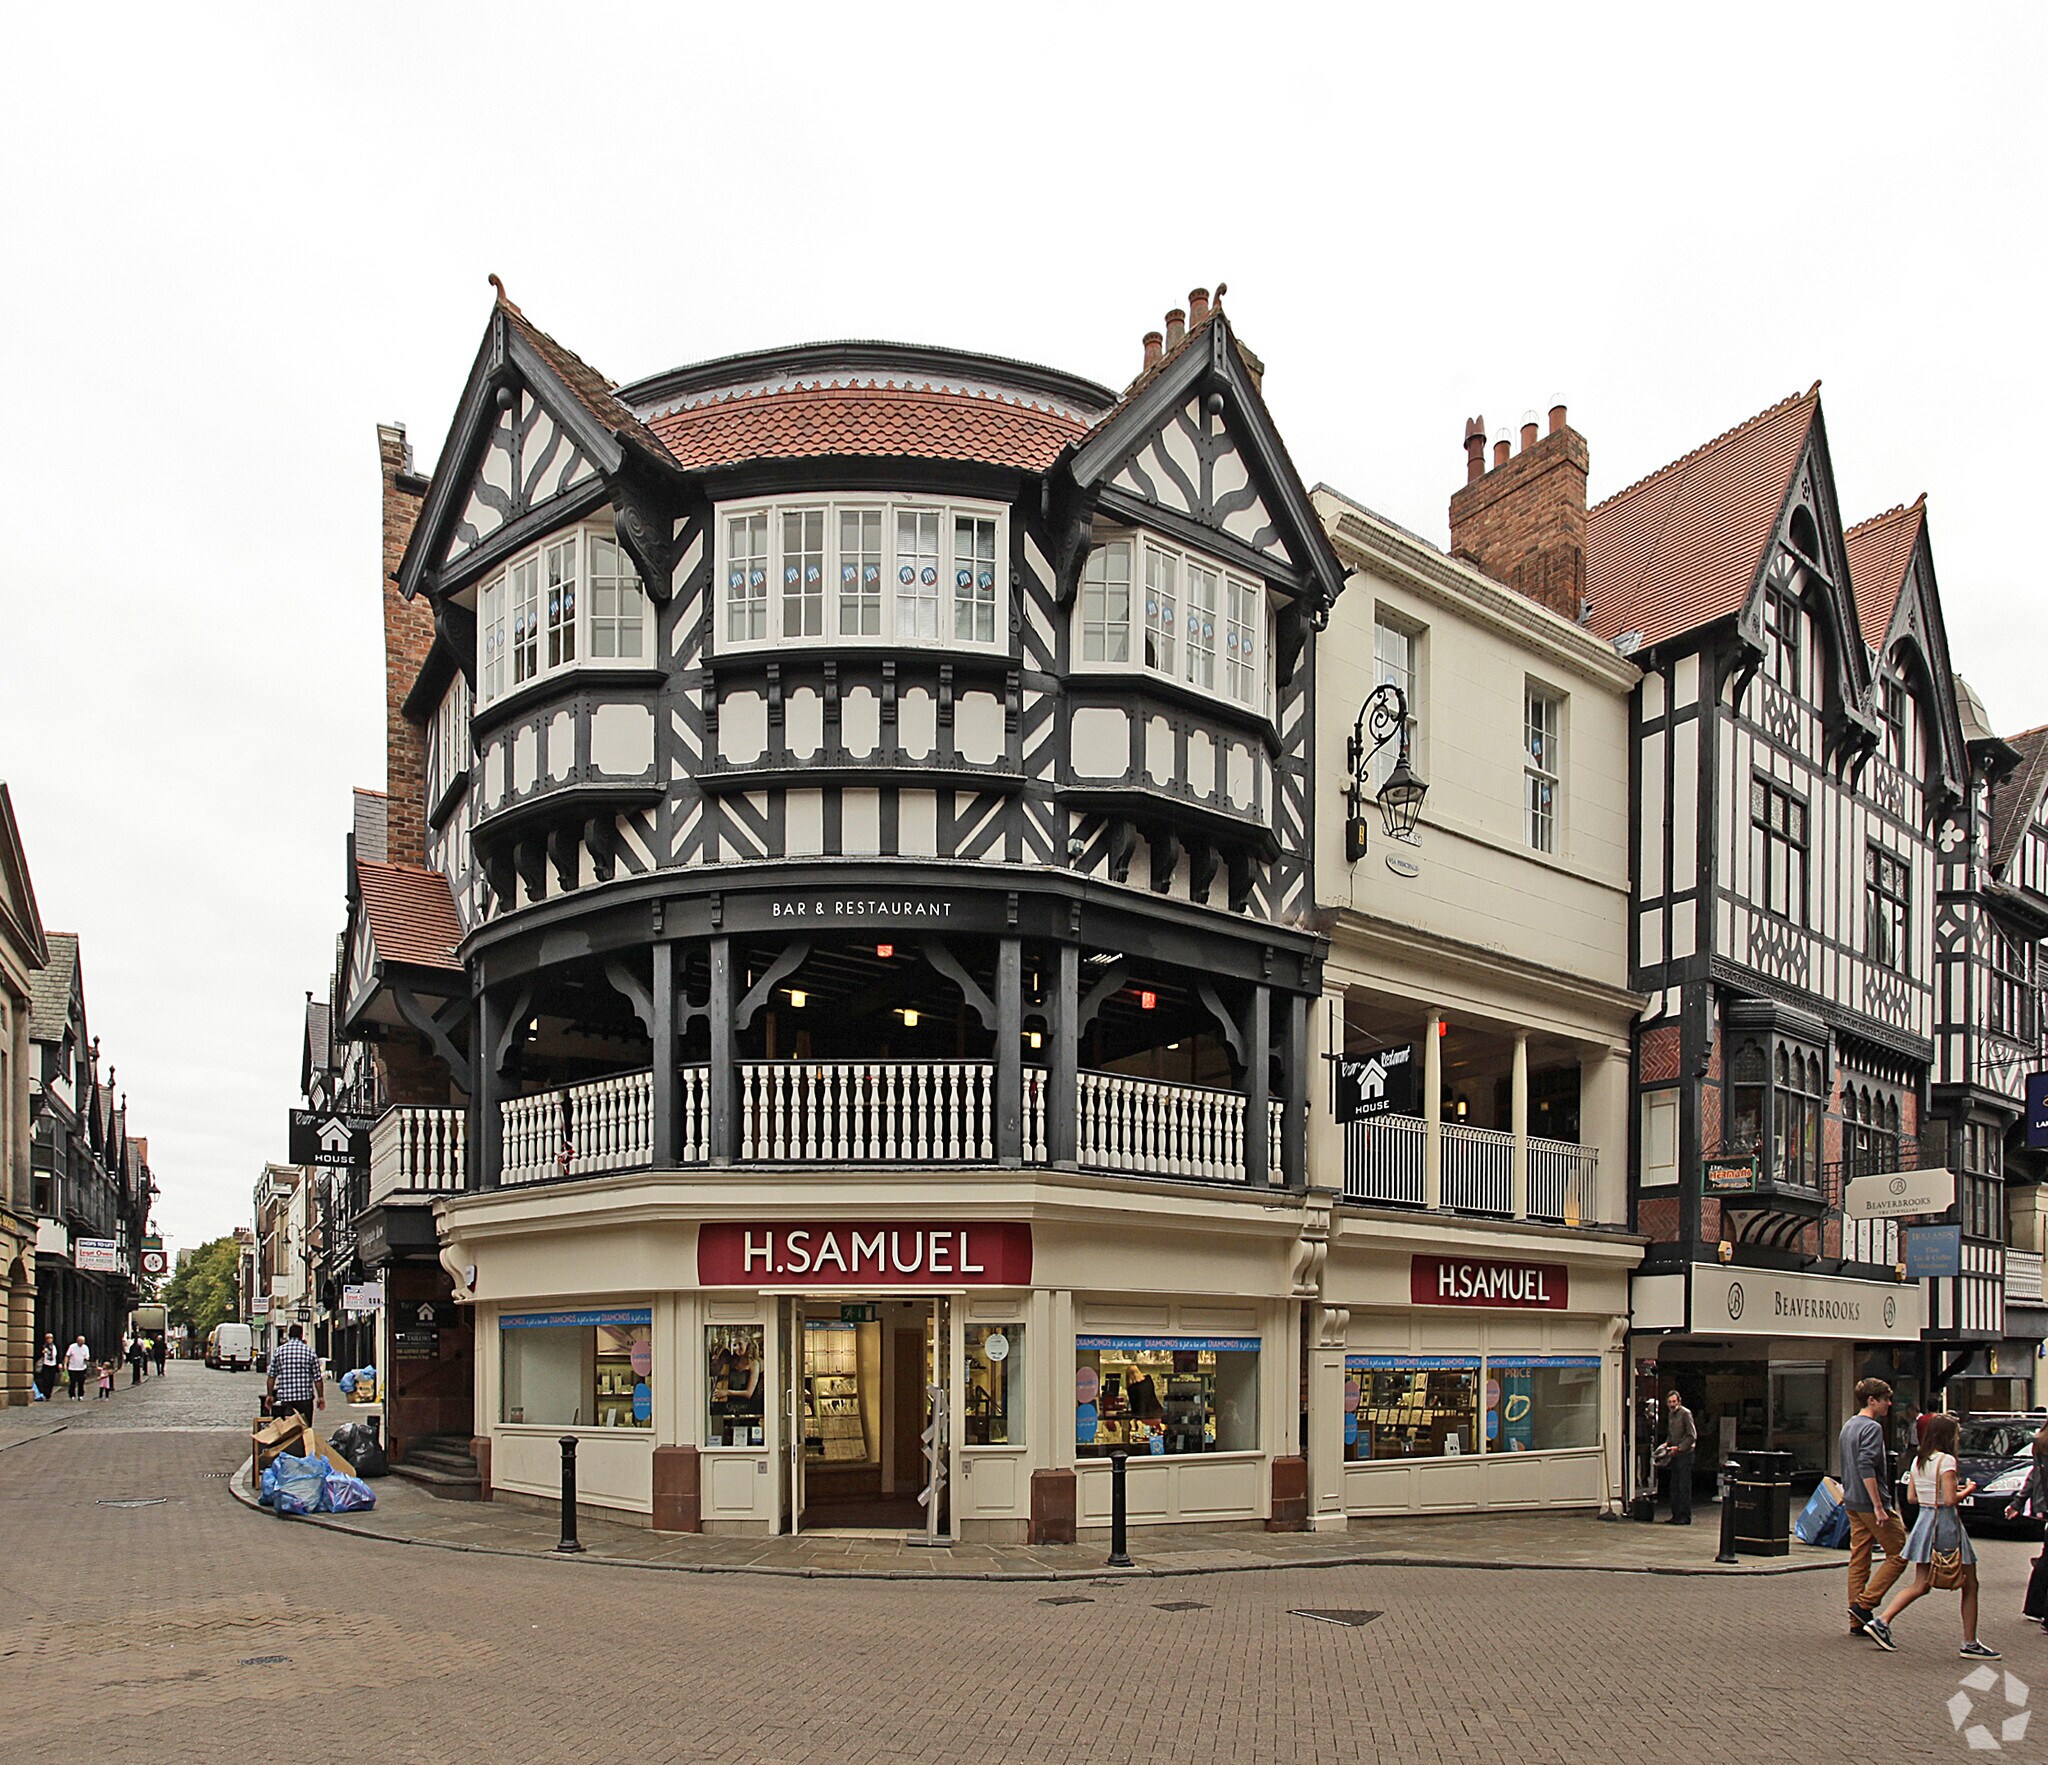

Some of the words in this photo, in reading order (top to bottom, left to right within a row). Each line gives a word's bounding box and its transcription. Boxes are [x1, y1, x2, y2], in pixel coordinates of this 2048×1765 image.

[773, 902, 806, 917] BAR
[815, 901, 825, 915] &
[835, 901, 951, 916] RESTAURANT
[1355, 1100, 1390, 1115] HOUSE
[315, 1154, 356, 1164] HOUSE
[1866, 1197, 1931, 1211] BEAVERBROOKS
[744, 1231, 984, 1273] H.SAMUEL
[1438, 1264, 1551, 1301] H.SAMUEL
[1774, 1291, 1860, 1321] BEAVERBROOKS
[1076, 1338, 1112, 1347] DIAMONDS
[1145, 1339, 1179, 1348] DIAMONDS
[1208, 1340, 1239, 1349] DIAMONDS
[1505, 1368, 1532, 1378] PRICE
